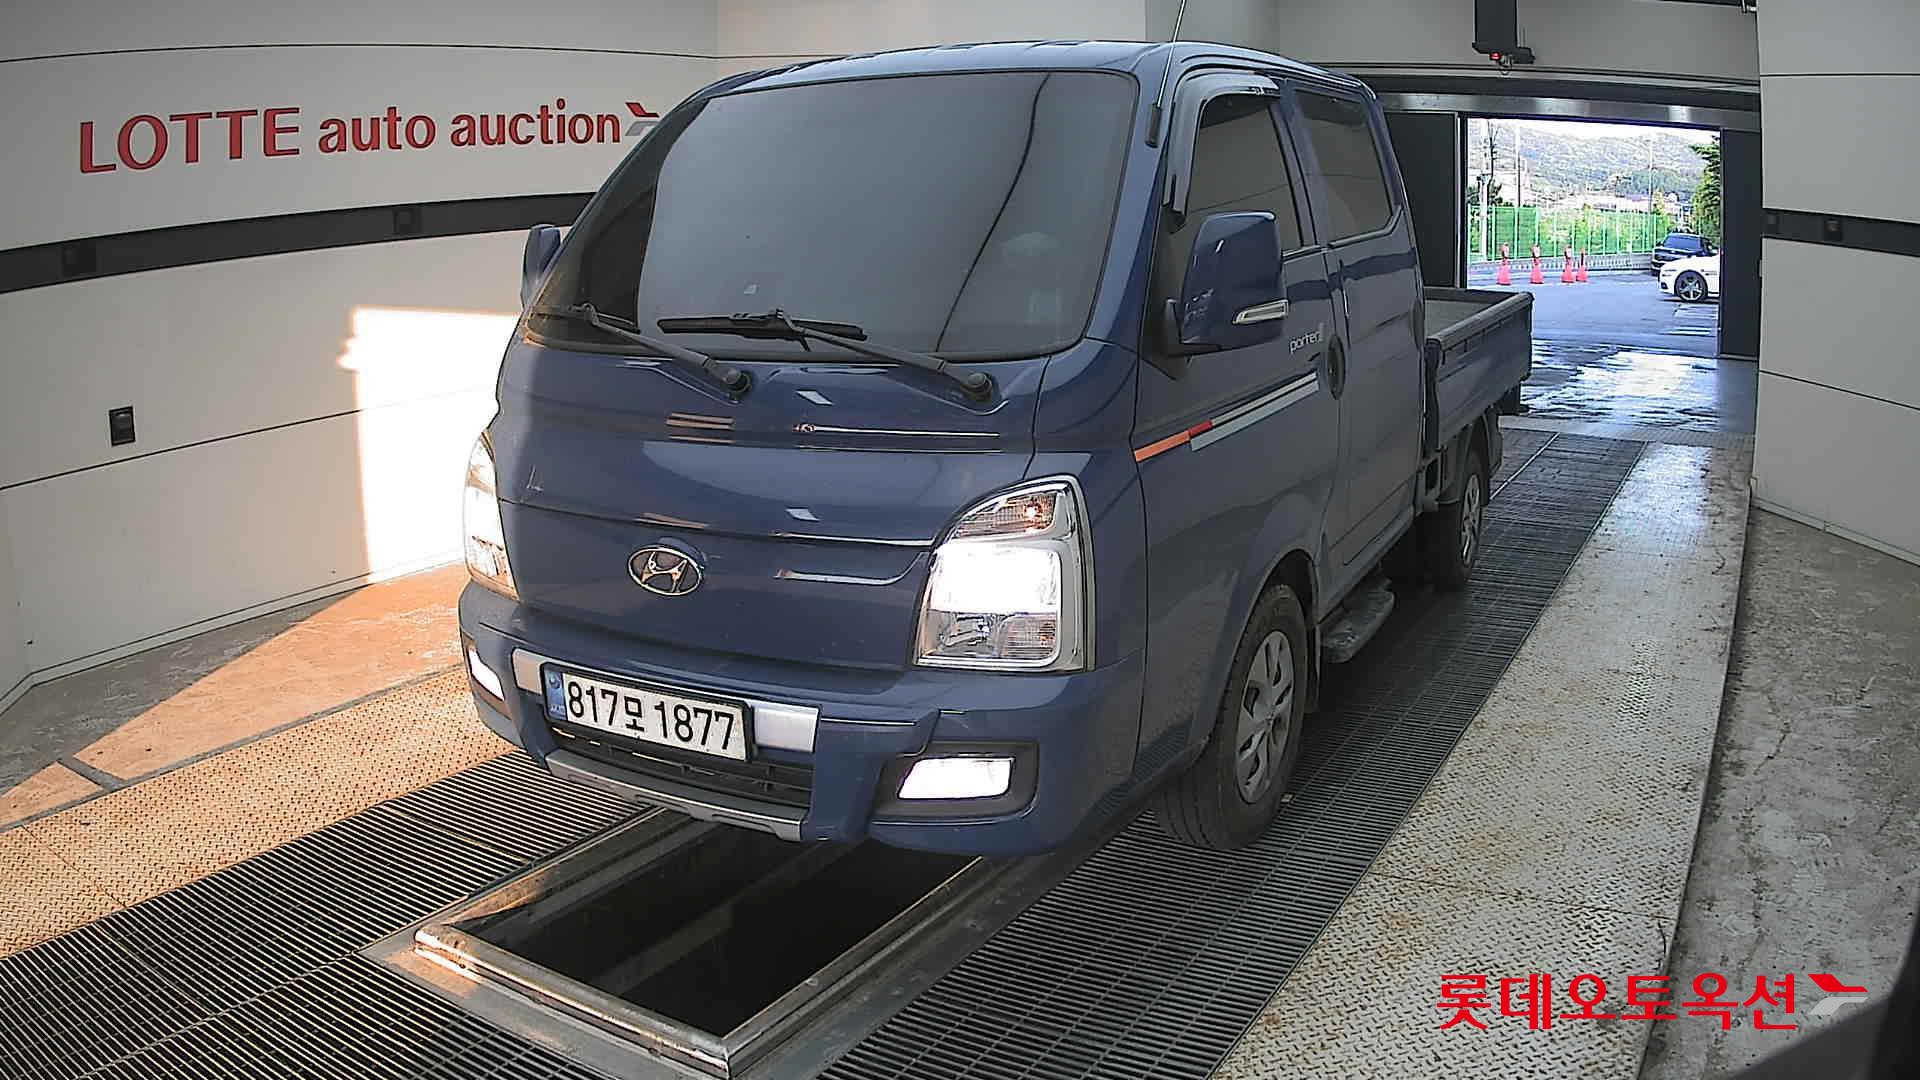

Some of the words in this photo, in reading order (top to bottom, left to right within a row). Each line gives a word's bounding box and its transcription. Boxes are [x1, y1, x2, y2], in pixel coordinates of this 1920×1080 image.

[80, 107, 300, 173] LOTTE
[318, 106, 436, 154] auto
[450, 99, 621, 147] auction
[567, 680, 646, 733] 817모
[654, 700, 734, 750] 1877
